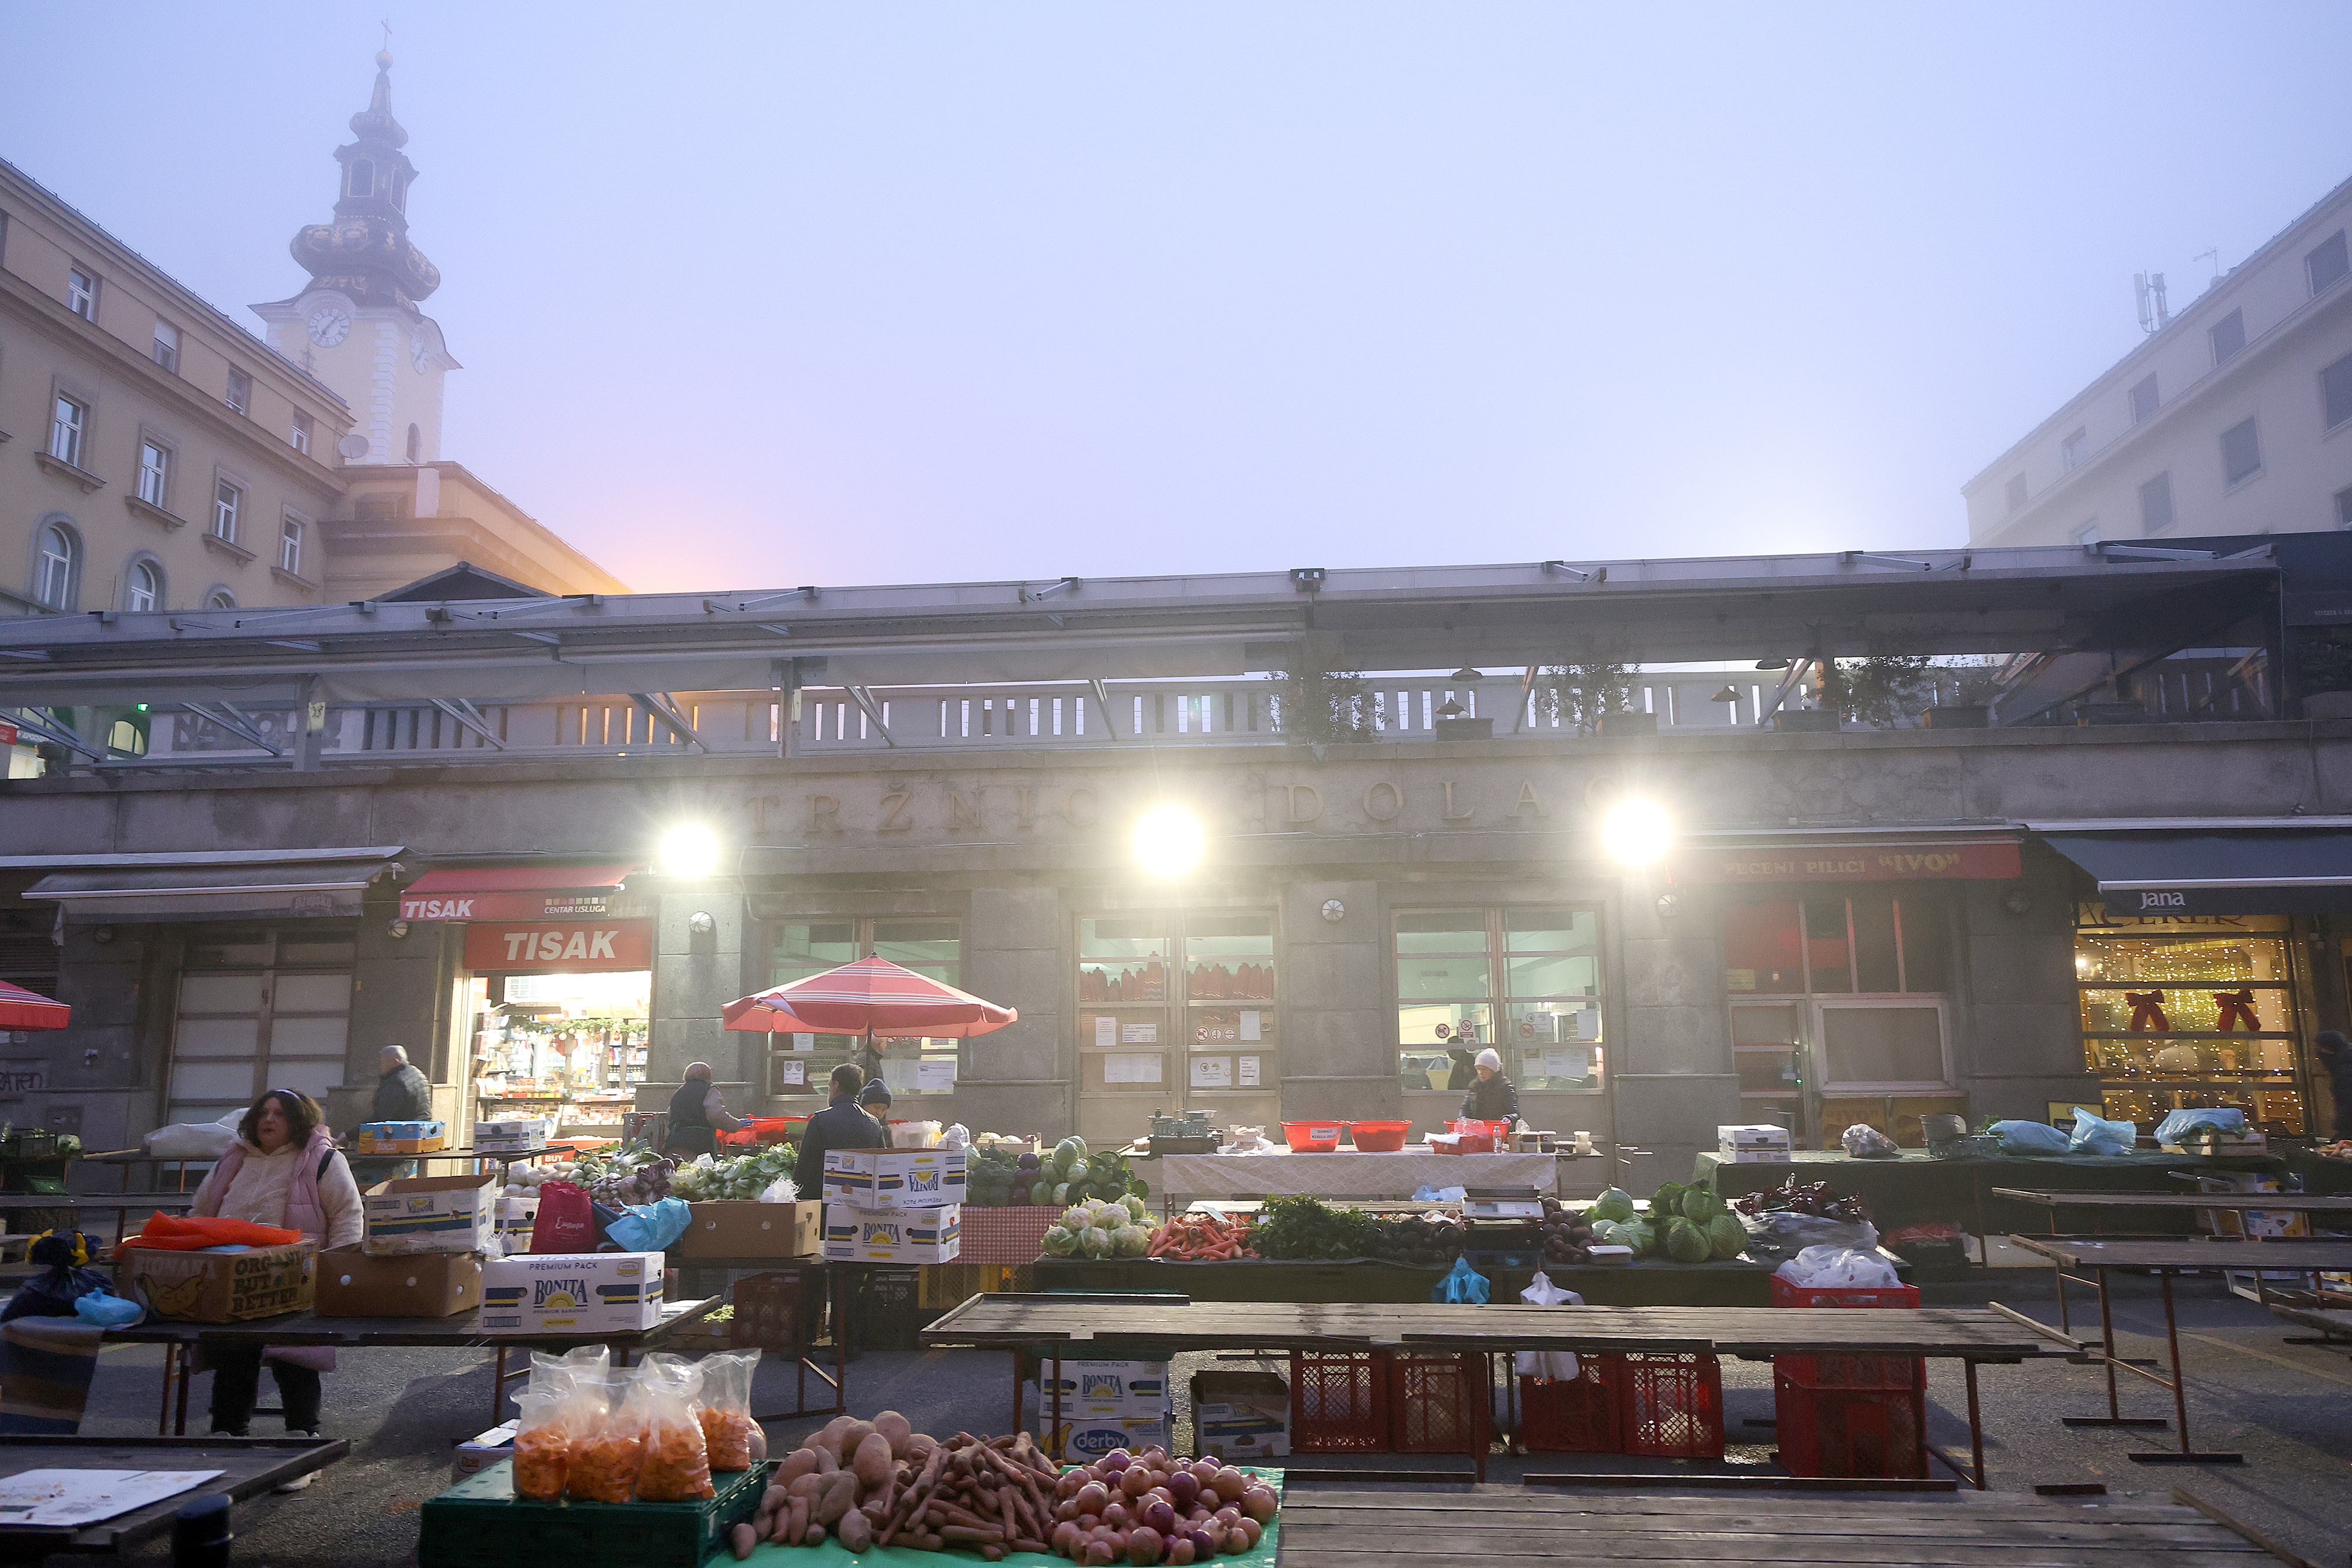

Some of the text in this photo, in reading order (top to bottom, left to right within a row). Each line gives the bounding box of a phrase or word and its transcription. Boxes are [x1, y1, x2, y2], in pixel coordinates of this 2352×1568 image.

[743, 783, 1101, 835] TRŽNIC
[405, 899, 474, 919] TISAK
[544, 904, 606, 914] CENTAR USLUGA
[2139, 892, 2186, 910] jana
[504, 930, 619, 961] TISAK
[908, 1172, 939, 1192] BONITA
[863, 1222, 901, 1242] BONITA
[235, 1250, 312, 1275] ORGANI
[529, 1262, 597, 1271] PREMIUM PACK
[232, 1287, 299, 1313] BETTER
[533, 1279, 588, 1305] BONITA
[1082, 1374, 1124, 1395] BONITA
[1076, 1432, 1125, 1450] derby
